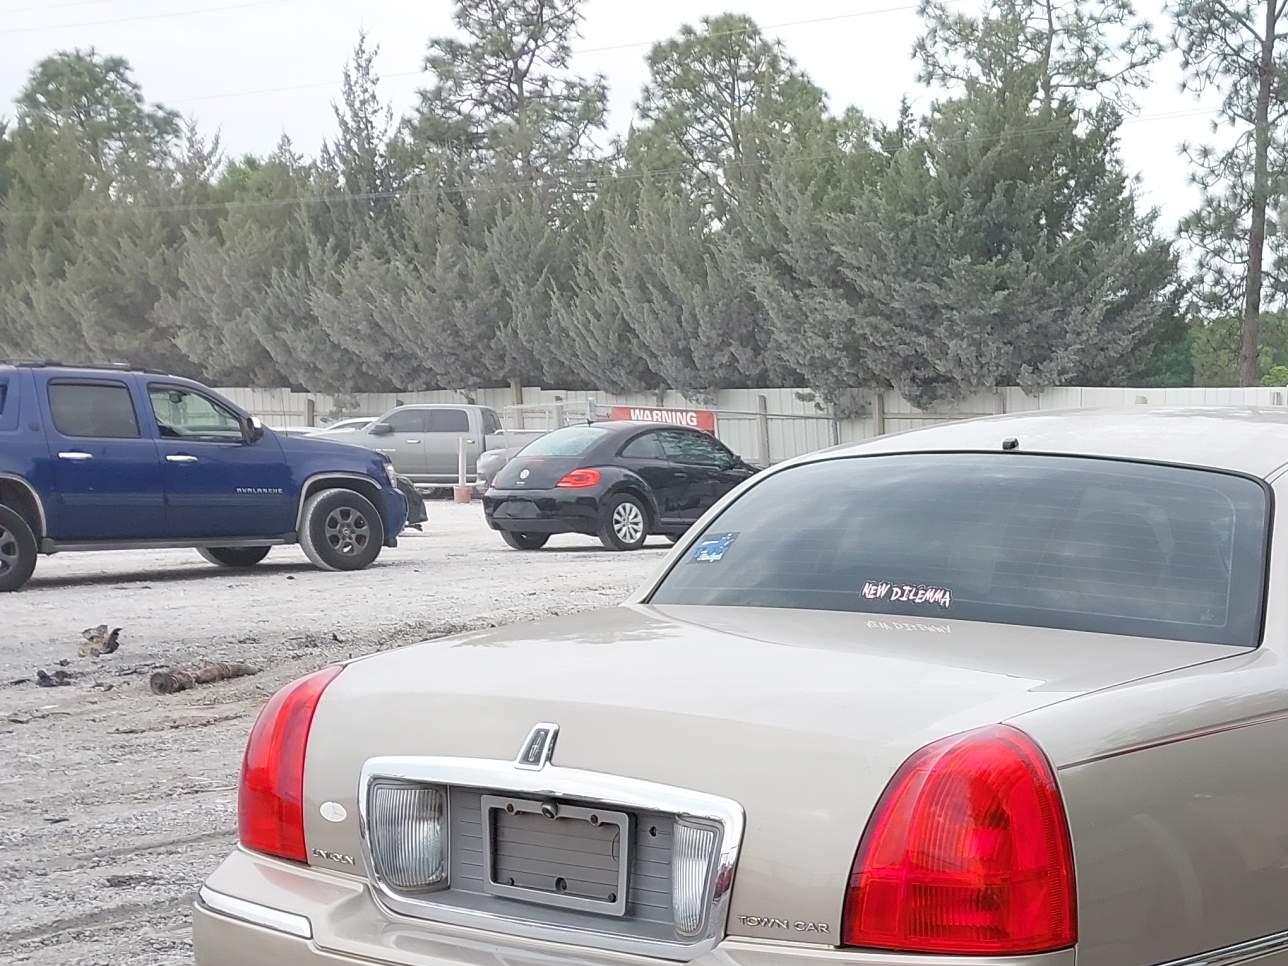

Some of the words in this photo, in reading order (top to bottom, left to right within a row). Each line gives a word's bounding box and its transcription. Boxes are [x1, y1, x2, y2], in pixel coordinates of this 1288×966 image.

[630, 409, 697, 425] WARNING
[862, 582, 890, 599] NEW
[890, 586, 950, 608] DILEMMA
[736, 915, 789, 929] TOWN
[794, 920, 830, 933] CAR
